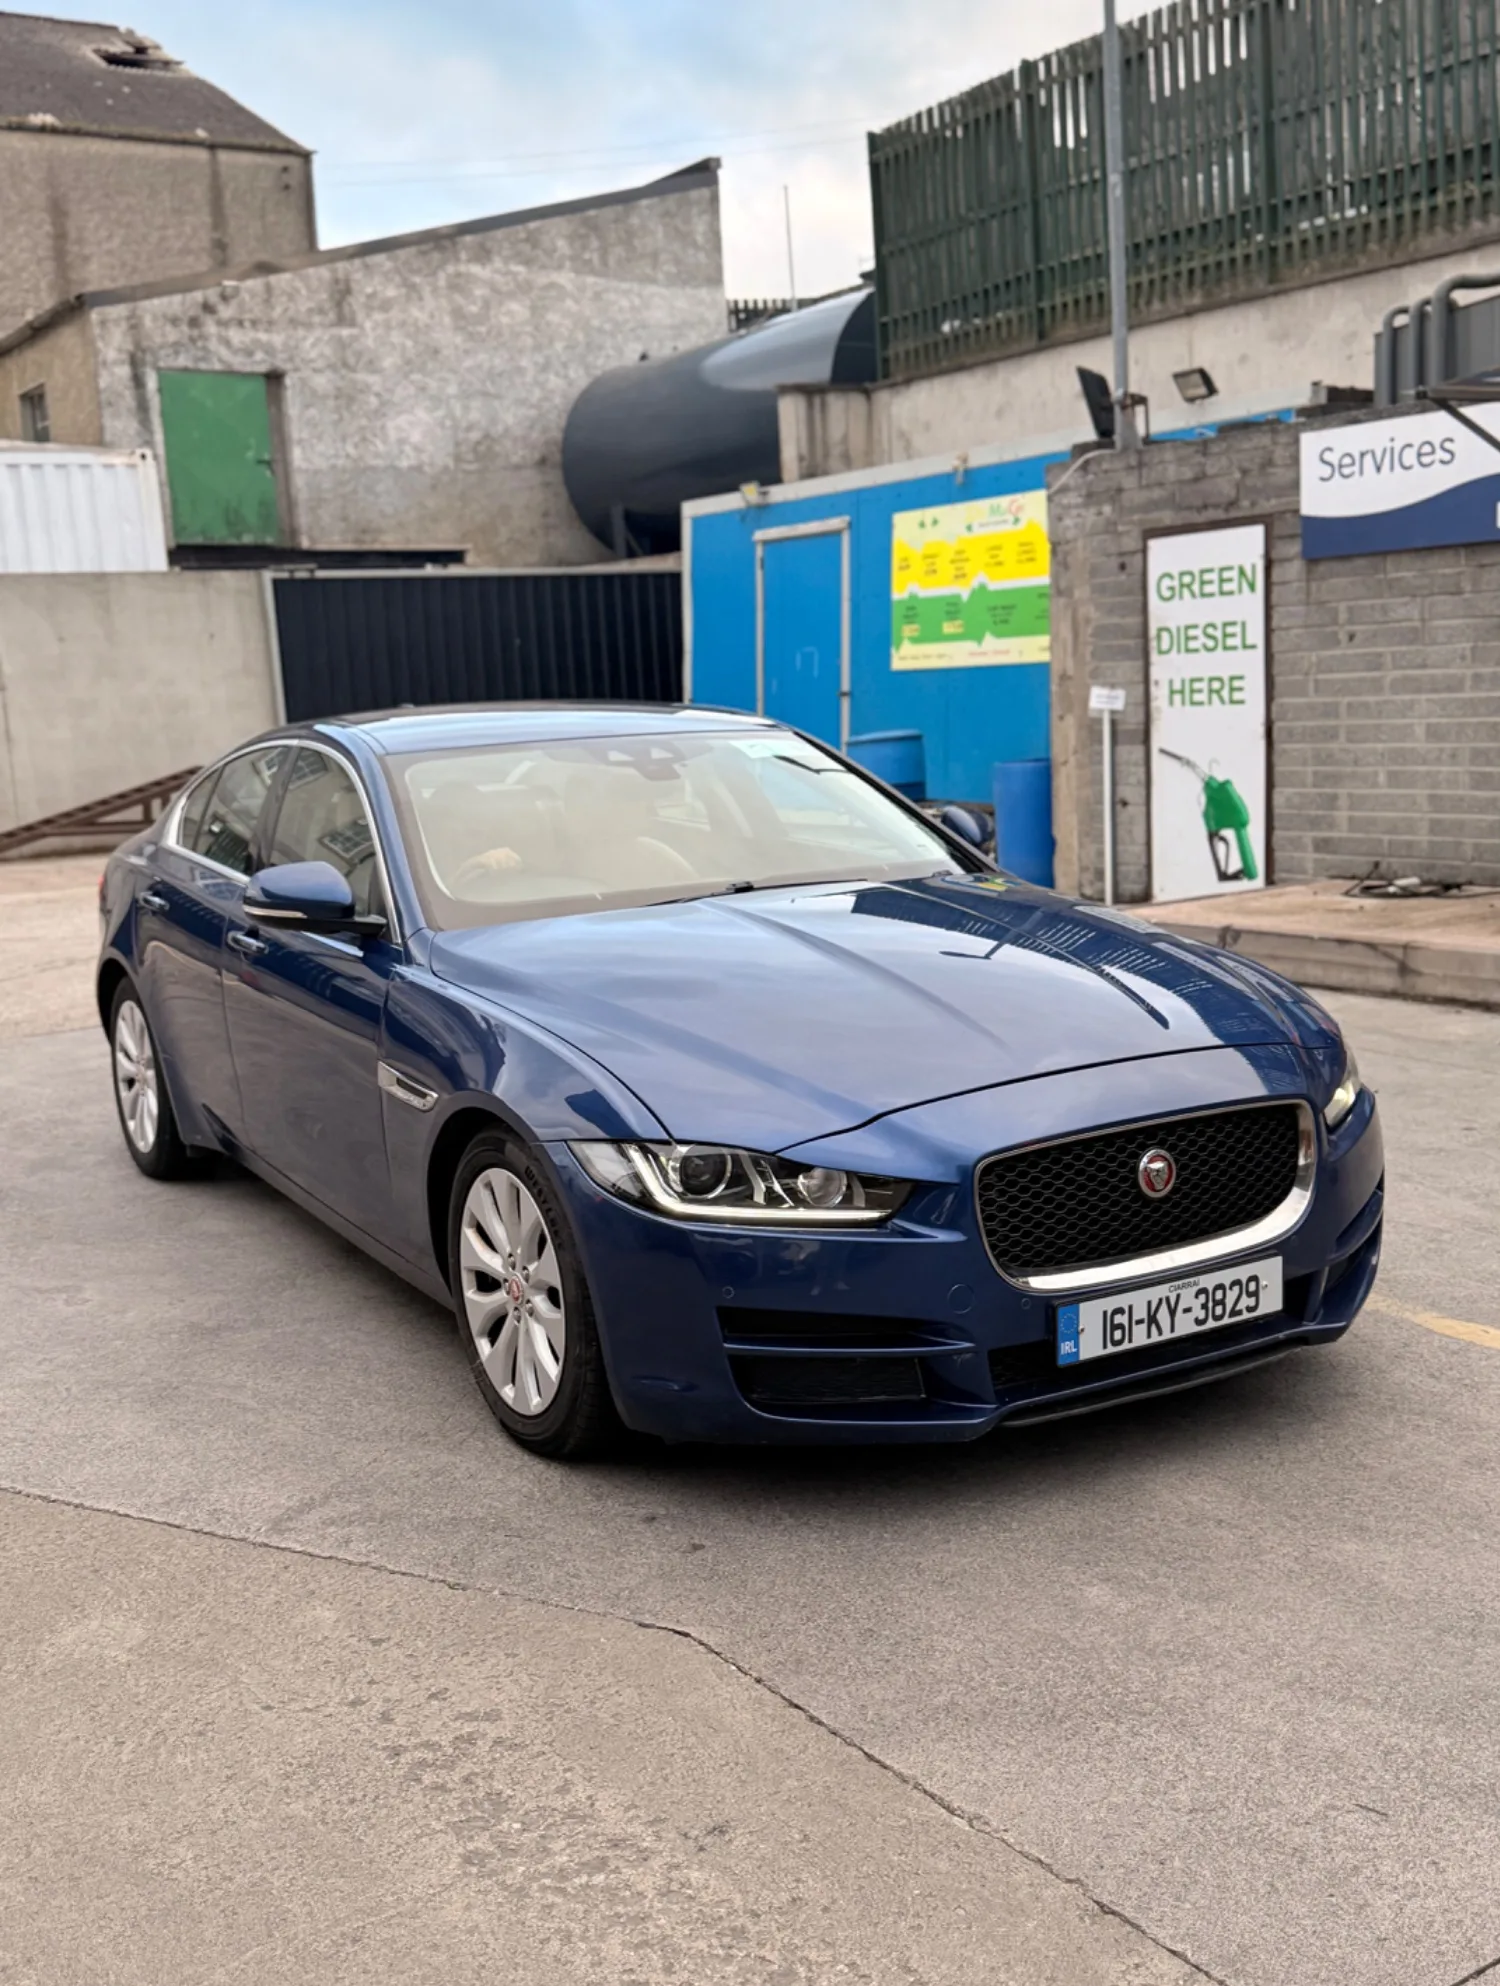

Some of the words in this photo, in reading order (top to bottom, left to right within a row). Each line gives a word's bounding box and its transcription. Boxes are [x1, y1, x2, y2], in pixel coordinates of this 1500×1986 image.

[1318, 436, 1457, 483] Services
[1155, 563, 1258, 603] GREEN
[1155, 620, 1259, 656] DIESEL
[1167, 674, 1247, 708] HERE
[1102, 1274, 1261, 1350] 161-KY-3829
[1060, 1339, 1078, 1356] IRL
